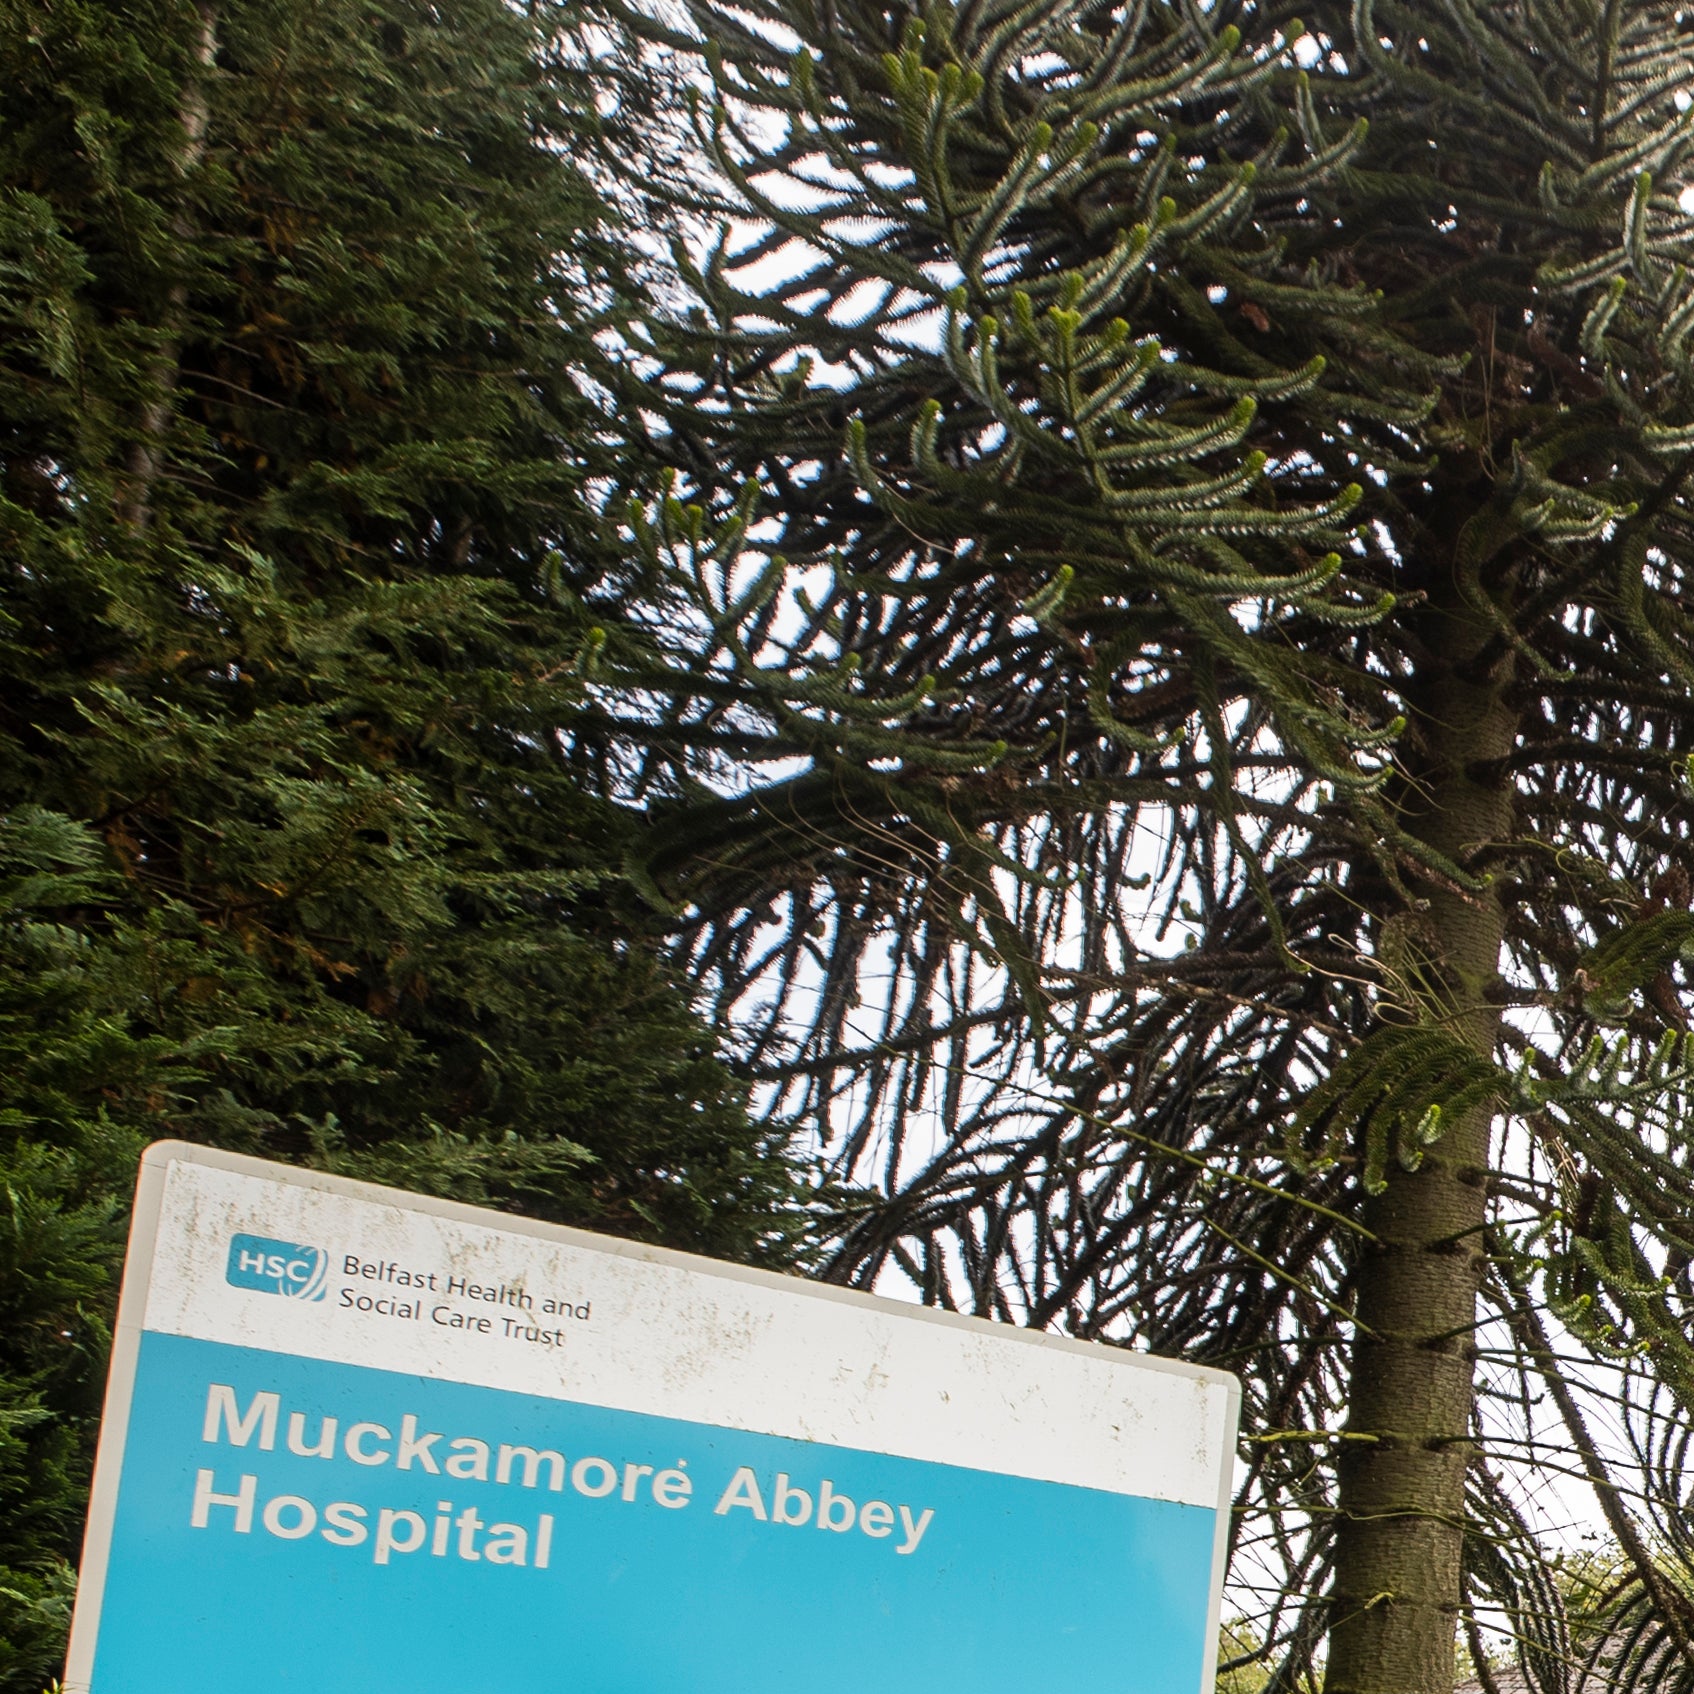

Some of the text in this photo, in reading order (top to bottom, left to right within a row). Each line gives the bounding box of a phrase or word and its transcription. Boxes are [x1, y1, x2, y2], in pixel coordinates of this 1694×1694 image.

[239, 1249, 310, 1283] HSC
[343, 1254, 592, 1322] Belfast Health and
[338, 1288, 566, 1348] Social Care Trust
[202, 1382, 935, 1555] Muckamore Abbey
[190, 1467, 555, 1570] Hospital
